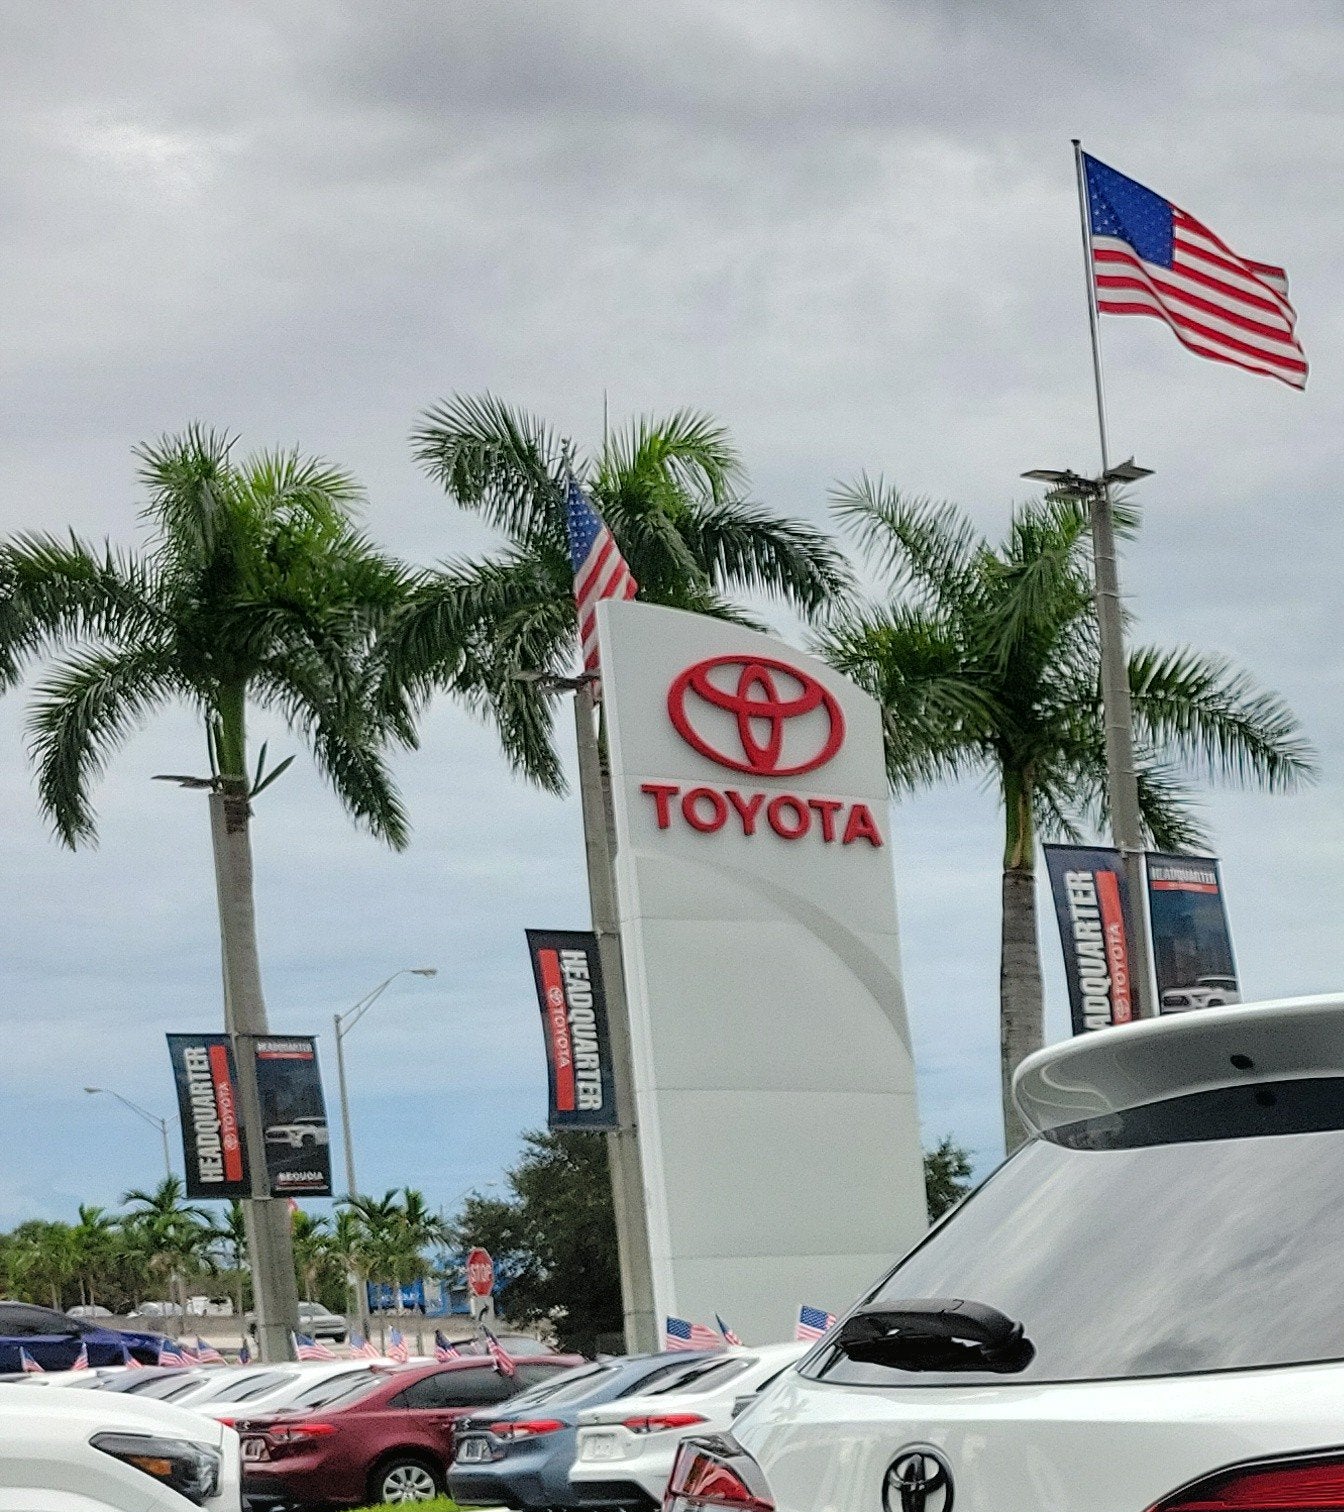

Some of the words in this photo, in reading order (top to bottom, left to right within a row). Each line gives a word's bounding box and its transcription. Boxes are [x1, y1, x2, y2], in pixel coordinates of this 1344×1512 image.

[641, 783, 884, 848] TOYOTA
[1064, 870, 1112, 1030] ADQUARTER
[1106, 923, 1126, 996] TOYOTA
[553, 1007, 571, 1068] TOYOTA
[560, 949, 603, 1111] HEADQUARTER
[184, 1046, 225, 1183] HEADQUARTER
[219, 1082, 239, 1134] TOYOTA
[470, 1263, 492, 1282] STOP
